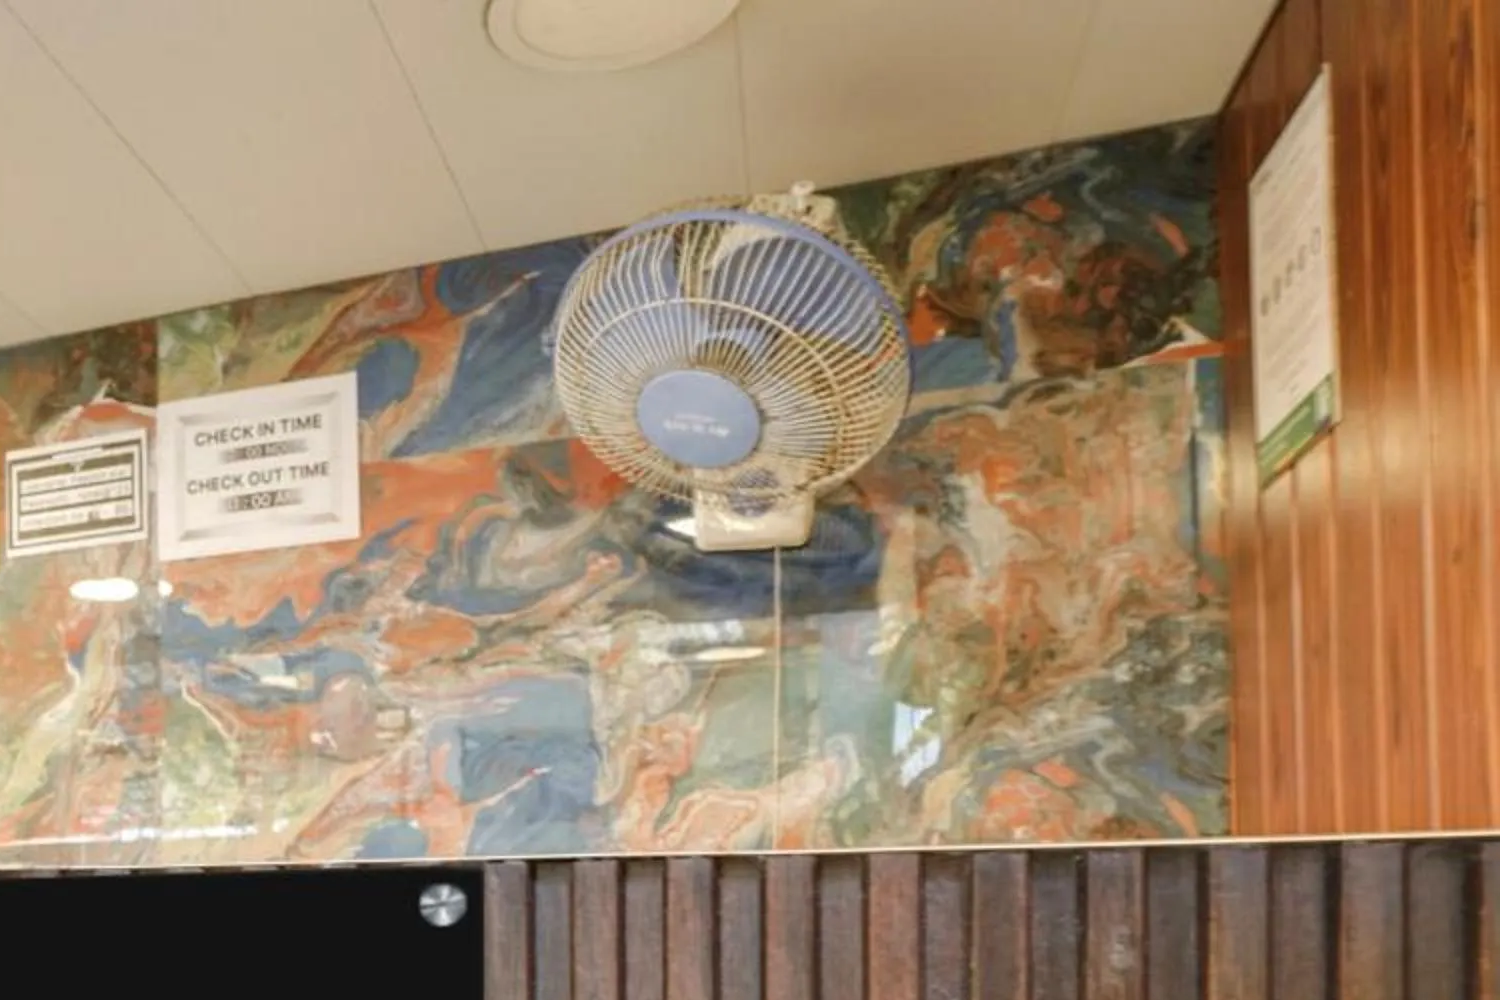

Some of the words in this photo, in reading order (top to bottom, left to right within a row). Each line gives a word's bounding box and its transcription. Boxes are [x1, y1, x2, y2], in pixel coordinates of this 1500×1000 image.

[193, 425, 255, 447] CHECK
[257, 421, 276, 437] IN
[279, 413, 323, 434] TIME
[186, 473, 244, 495] CHECK
[247, 467, 283, 487] OUT
[289, 461, 330, 480] TIME
